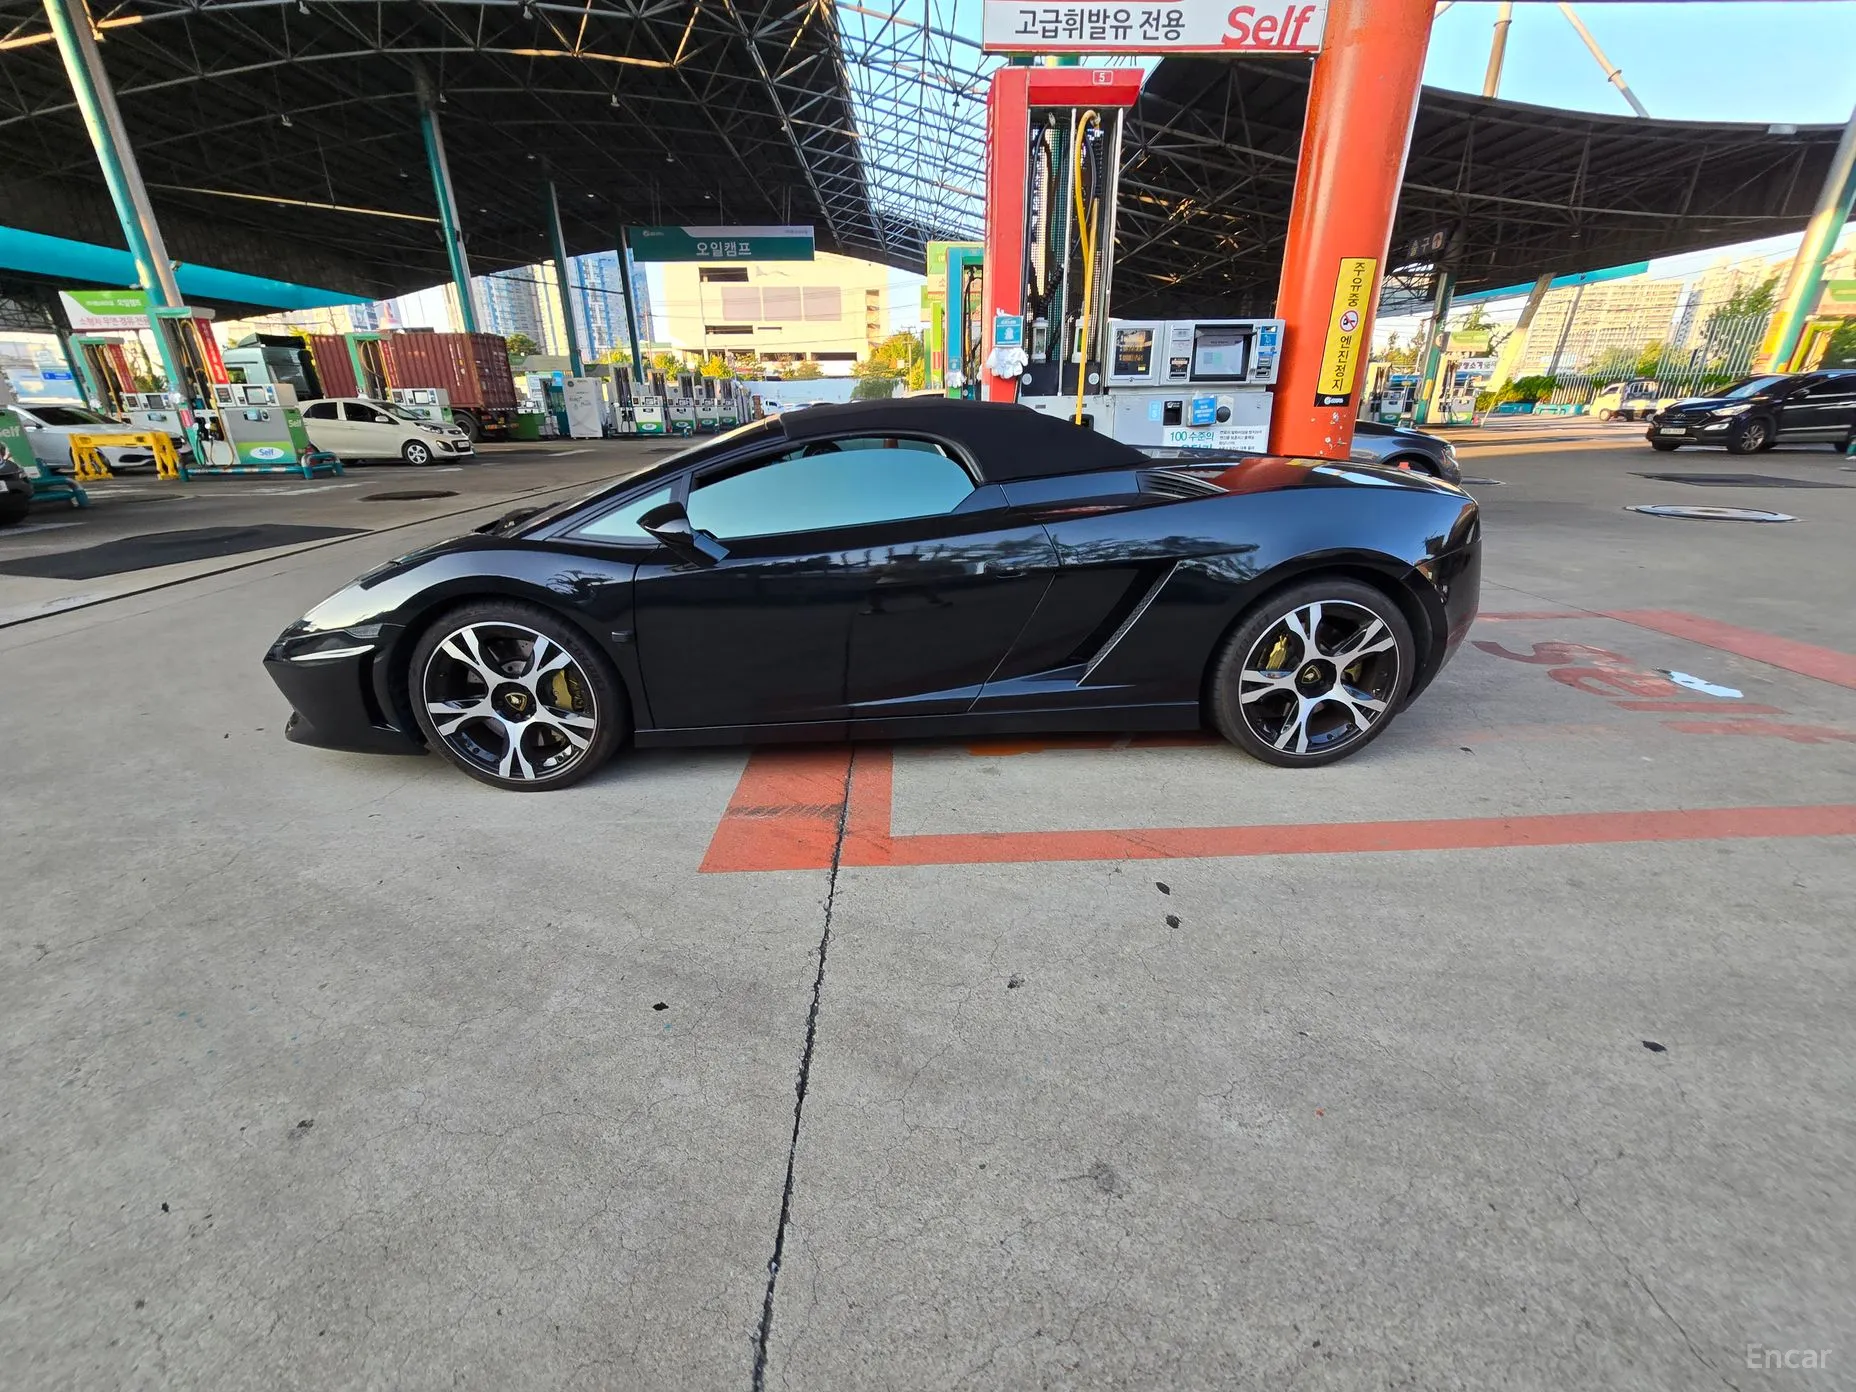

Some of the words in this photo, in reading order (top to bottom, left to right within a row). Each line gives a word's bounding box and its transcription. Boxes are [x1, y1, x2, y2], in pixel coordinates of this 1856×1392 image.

[1014, 8, 1133, 40] 고급휘발유
[1139, 8, 1186, 41] 전용
[1221, 5, 1316, 46] Self
[1098, 72, 1106, 83] 5
[696, 242, 752, 257] 오일캠프
[1347, 262, 1366, 307] 주유중
[1331, 335, 1352, 391] 엔진정지
[0, 426, 20, 438] elf
[1170, 431, 1187, 441] 100
[1188, 431, 1215, 441] 수준의
[259, 448, 274, 457] Self
